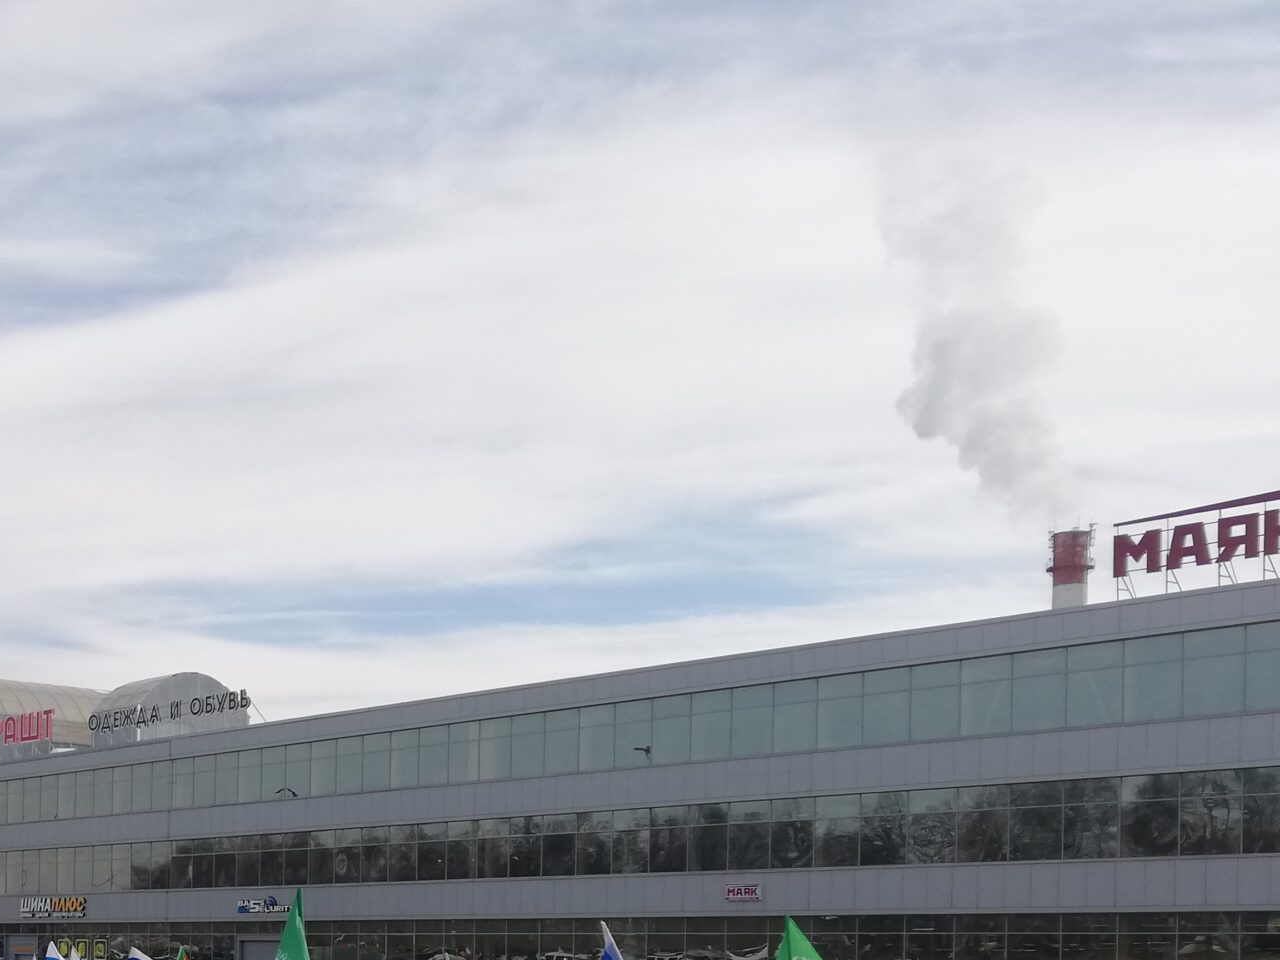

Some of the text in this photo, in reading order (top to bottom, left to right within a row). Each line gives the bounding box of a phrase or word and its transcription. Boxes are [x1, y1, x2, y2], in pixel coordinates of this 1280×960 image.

[88, 689, 252, 734] ОДЕЖДА И ОБУВЬ
[727, 887, 758, 897] МАЯК
